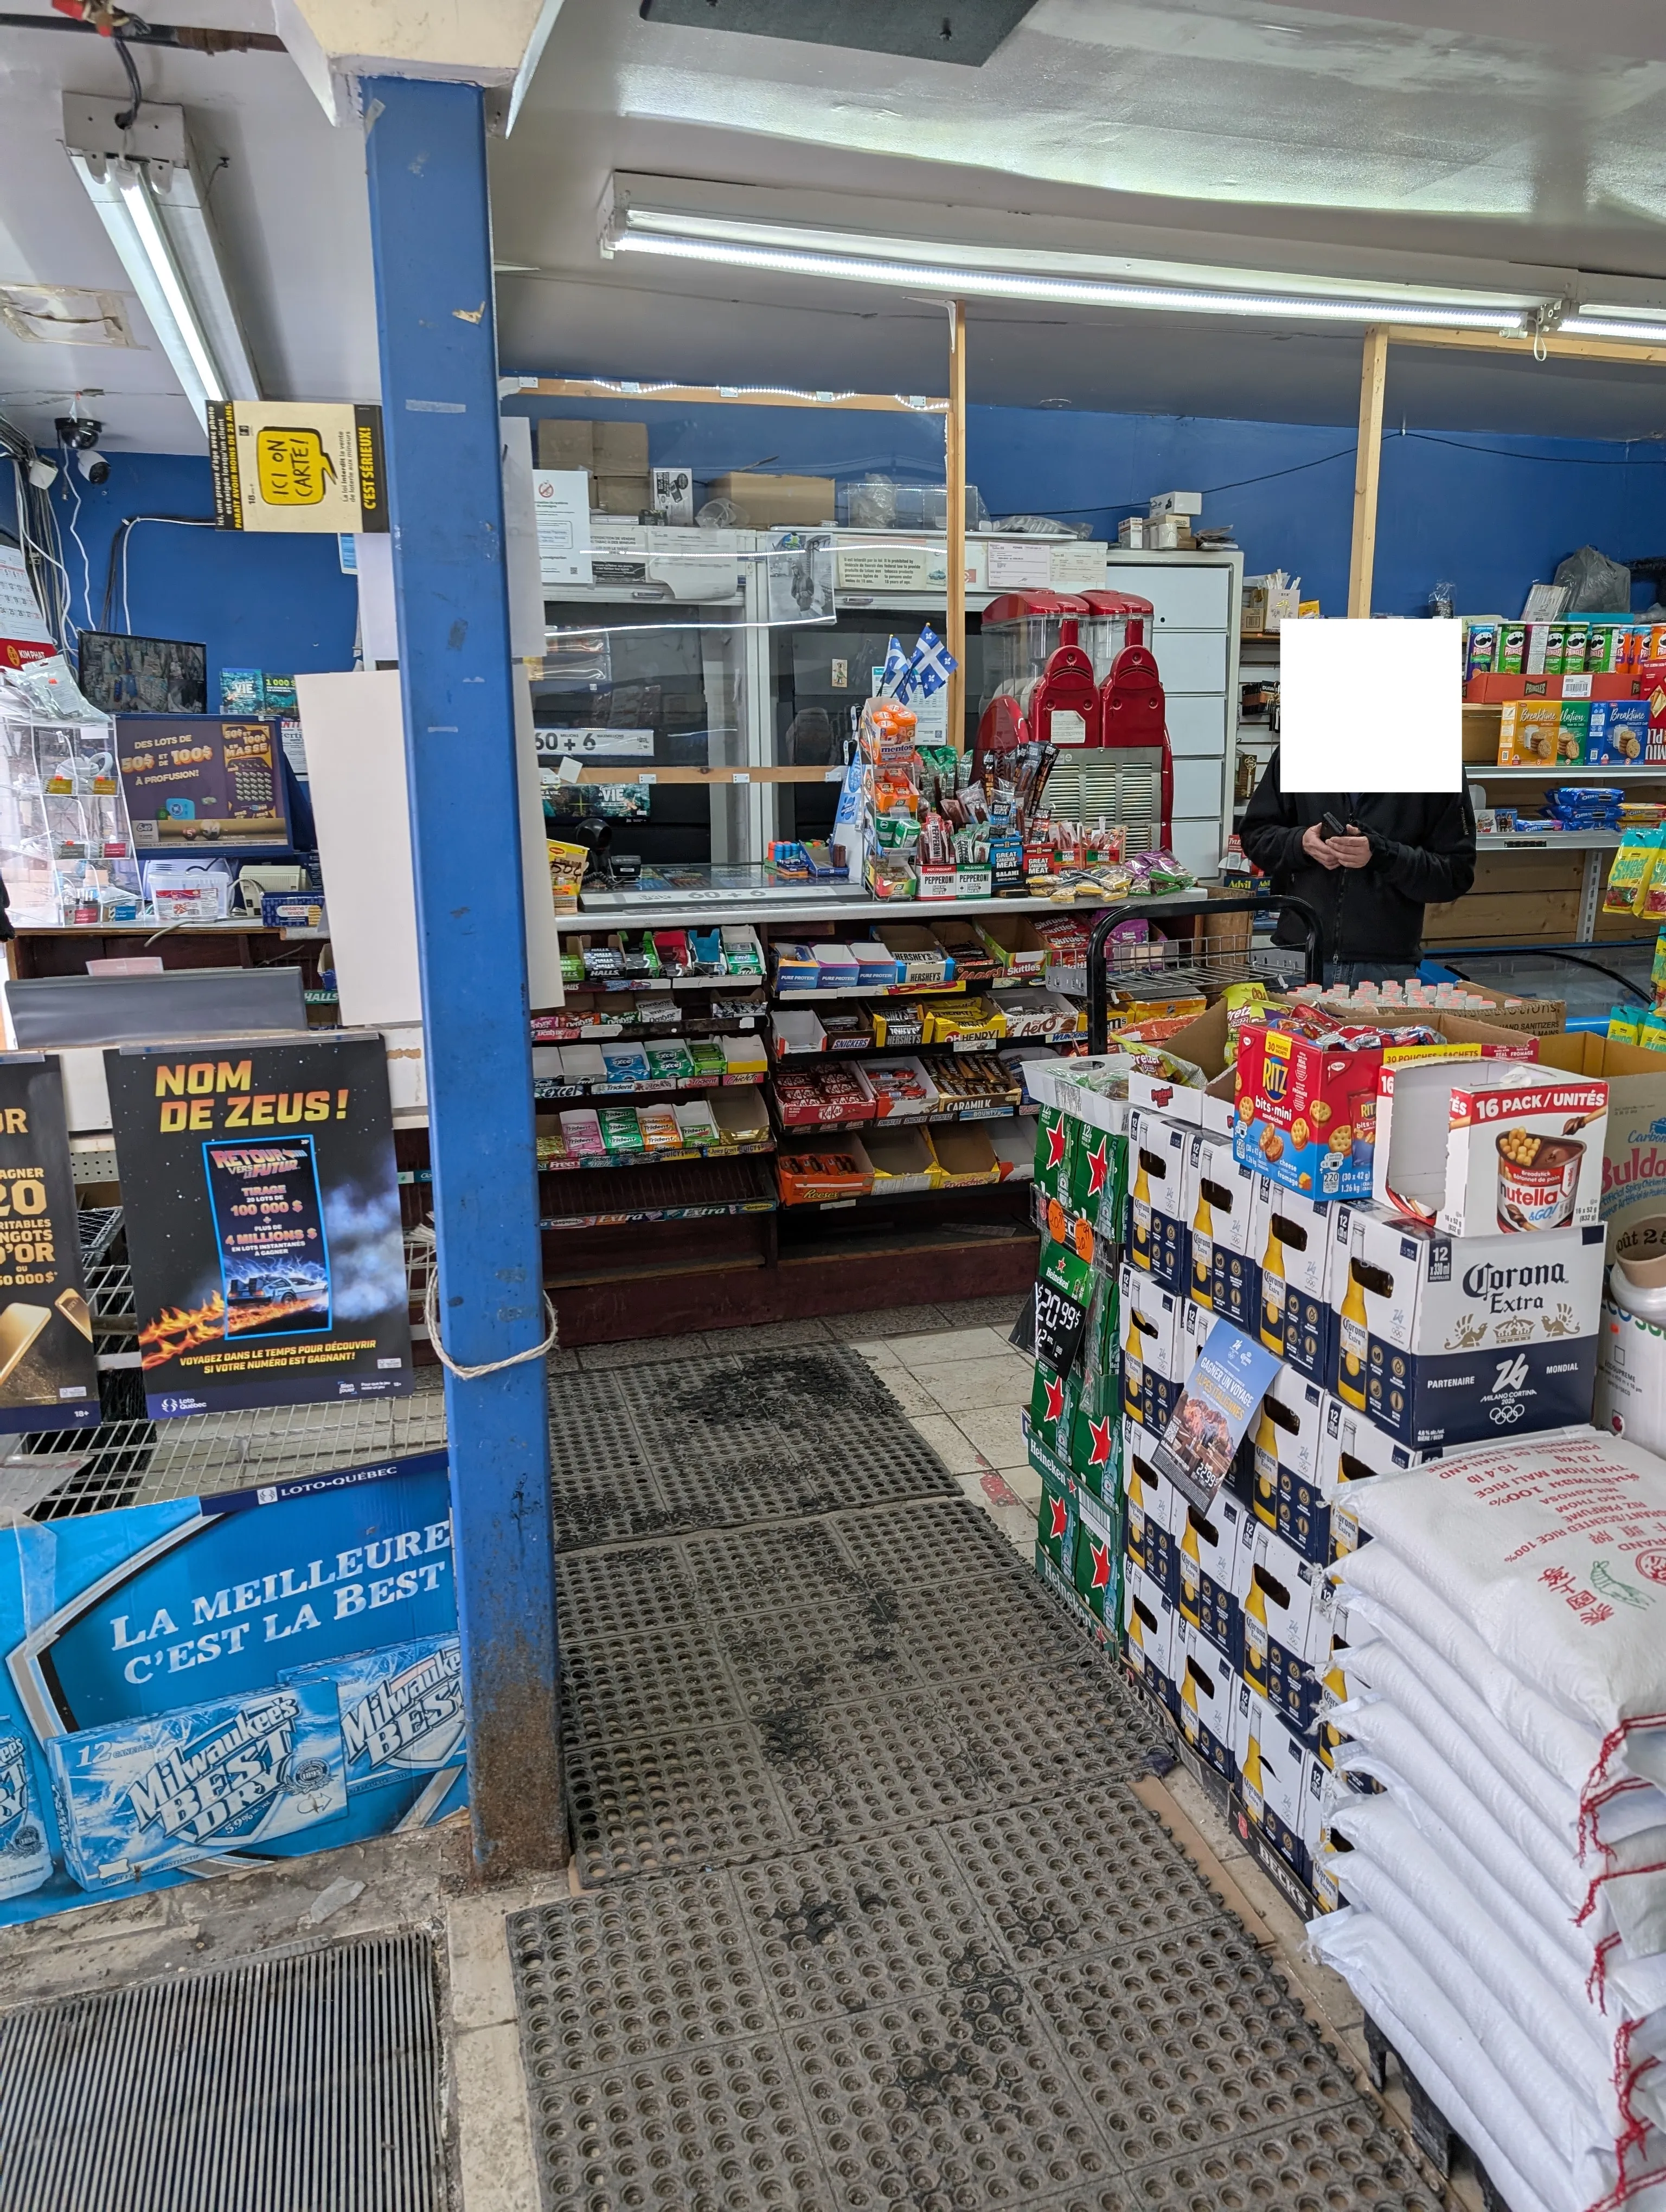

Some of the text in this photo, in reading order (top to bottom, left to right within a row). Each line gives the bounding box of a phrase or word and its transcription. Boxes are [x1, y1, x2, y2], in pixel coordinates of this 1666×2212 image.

[208, 407, 217, 429] photo
[217, 419, 226, 439] client
[226, 423, 234, 433] 25
[210, 431, 218, 448] avec
[227, 435, 235, 445] DE
[211, 451, 221, 470] d'âge
[219, 442, 229, 475] lorsqu'un
[228, 447, 237, 473] MOINS
[266, 440, 290, 495] ICI ON
[289, 439, 313, 497] CARTE!
[358, 427, 376, 509] C'EST SÉRIEUX!
[213, 473, 223, 497] preuve
[222, 478, 232, 501] exigée
[231, 475, 240, 498] AVOIR
[215, 499, 223, 513] une
[30, 651, 45, 659] PHAT
[1473, 647, 1491, 657] PRINGLES
[1526, 682, 1546, 695] PRINGLES
[1520, 708, 1556, 722] Breaktime
[1610, 708, 1644, 722] Breaktime
[134, 735, 193, 749] DES LOTS DE
[583, 733, 596, 750] 6
[881, 744, 913, 753] mentos
[121, 745, 213, 774] 50$ 100$
[136, 769, 200, 785] À PROFUSION!
[602, 789, 624, 801] VIE
[931, 825, 941, 857] PEPPERONI
[925, 875, 954, 884] PEPPERONI
[959, 874, 989, 882] PEPPERONI
[910, 972, 941, 982] HERSHEY'S
[1007, 964, 1041, 976] Skittles
[566, 1015, 595, 1027] Dentyne
[1520, 1021, 1559, 1030] SANITIZERS
[833, 1039, 869, 1049] SNICKERS
[1267, 1041, 1275, 1051] 30
[1276, 1044, 1288, 1052] POUCHES
[1276, 1049, 1287, 1057] SACHETS
[660, 1061, 682, 1070] excel
[155, 1060, 252, 1097] NOM
[726, 1074, 759, 1084] Chiclets
[1263, 1058, 1289, 1096] RITZ
[544, 1086, 577, 1097] excel
[818, 1106, 843, 1120] KitKat
[947, 1099, 992, 1111] CARAMILK
[1476, 1098, 1498, 1118] 16
[160, 1099, 215, 1133] DE
[210, 1149, 286, 1168] RETOUR
[228, 1165, 253, 1175] VERS
[253, 1160, 299, 1177] FUTUR
[1521, 1170, 1551, 1178] Breadstick
[1278, 1171, 1298, 1187] fromage
[241, 1185, 286, 1197] TIRAGE
[803, 1189, 838, 1199] Reese's
[1500, 1182, 1559, 1206] nutella
[230, 1200, 303, 1216] 100 000 $
[598, 1212, 644, 1223] Extra
[226, 1227, 317, 1245] 4 MILLIONS $
[1432, 1246, 1449, 1262] 12
[1046, 1267, 1070, 1290] Heineken
[1462, 1262, 1566, 1301] Corona
[1489, 1293, 1545, 1315] Extra
[180, 1339, 376, 1366] VOYAGEZ DANS LE TEMPS POUR DÉCOUVRIR
[204, 1352, 355, 1374] SI VOTRE NUMÉRO EST GAGNANT!
[1200, 1356, 1254, 1407] GAGNER UN VOYAGE
[1427, 1362, 1579, 1388] PARTENAIRE MONDIAL
[179, 1397, 195, 1405] Loto
[1480, 1389, 1537, 1403] MILANO CORTINA
[179, 1401, 207, 1410] Québec
[1028, 1442, 1067, 1488] Heineken
[1590, 1464, 1629, 1474] THAI
[280, 1466, 398, 1497] LOTO-QUÉBEC
[1466, 1463, 1518, 1484] 15.4 lb
[1513, 1470, 1547, 1485] MALI
[1473, 1482, 1510, 1499] RICE
[109, 1520, 452, 1652] LA MEILLEURE
[123, 1561, 447, 1684] C'EST LA BEST
[126, 1692, 301, 1834] Milwaukee's
[1259, 1843, 1309, 1912] BECK'S
